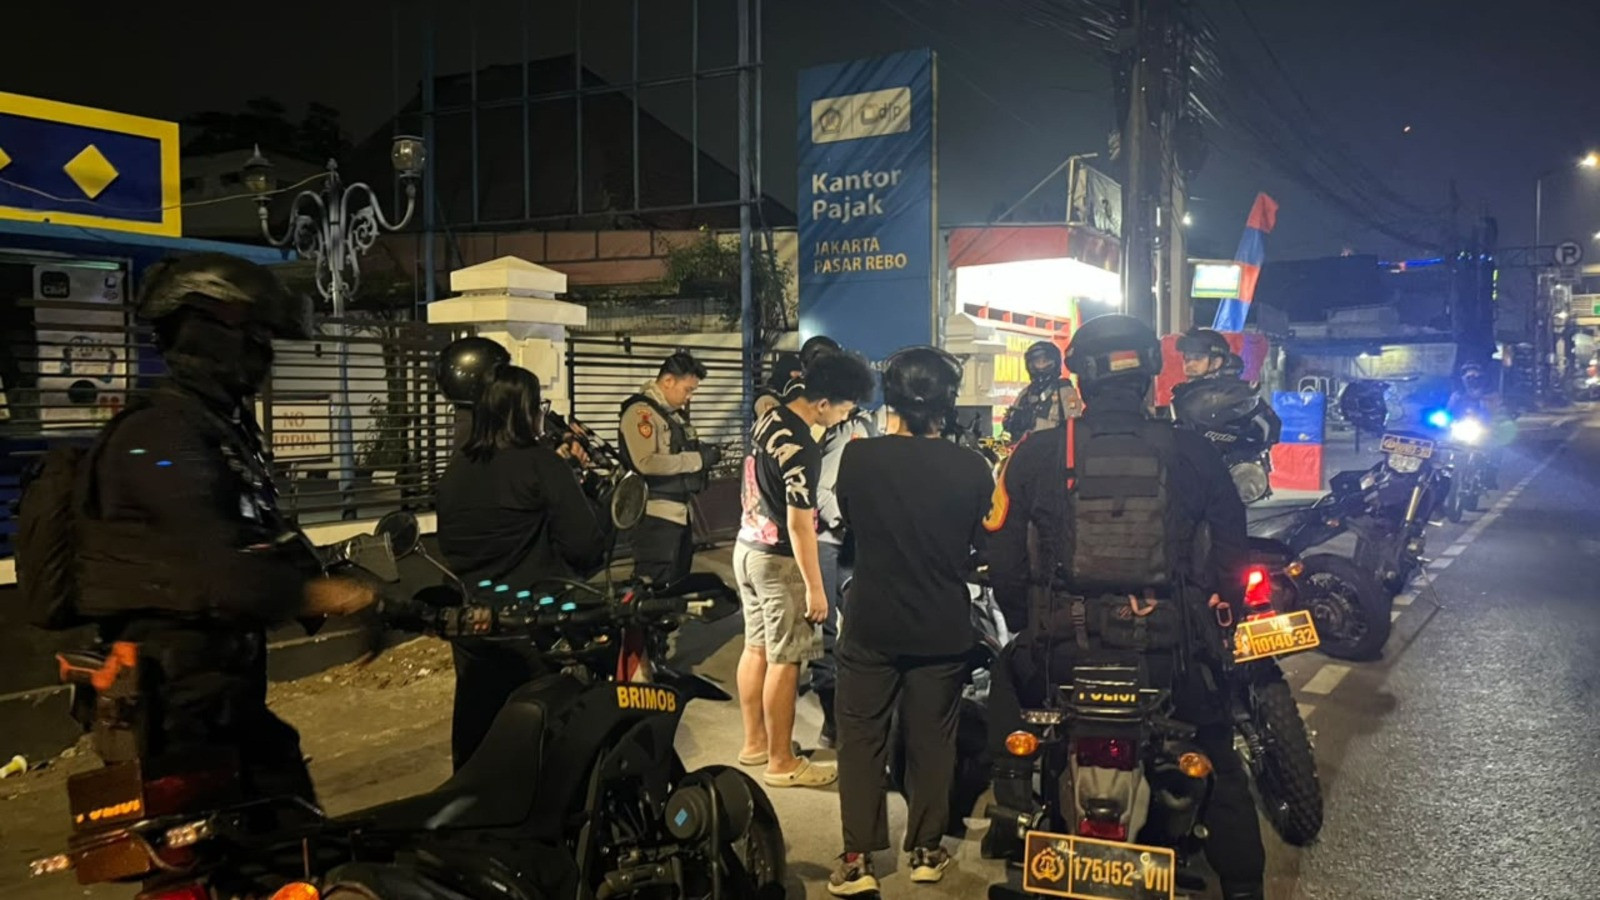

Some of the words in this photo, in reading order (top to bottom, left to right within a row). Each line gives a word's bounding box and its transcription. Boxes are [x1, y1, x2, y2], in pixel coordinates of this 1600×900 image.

[812, 169, 901, 194] Kantor
[813, 193, 883, 223] Pajak
[814, 237, 880, 257] JAKARTA
[814, 257, 862, 274] PASAR
[866, 253, 907, 271] REBO
[283, 411, 305, 428] NO
[616, 686, 676, 712] BRIMOB
